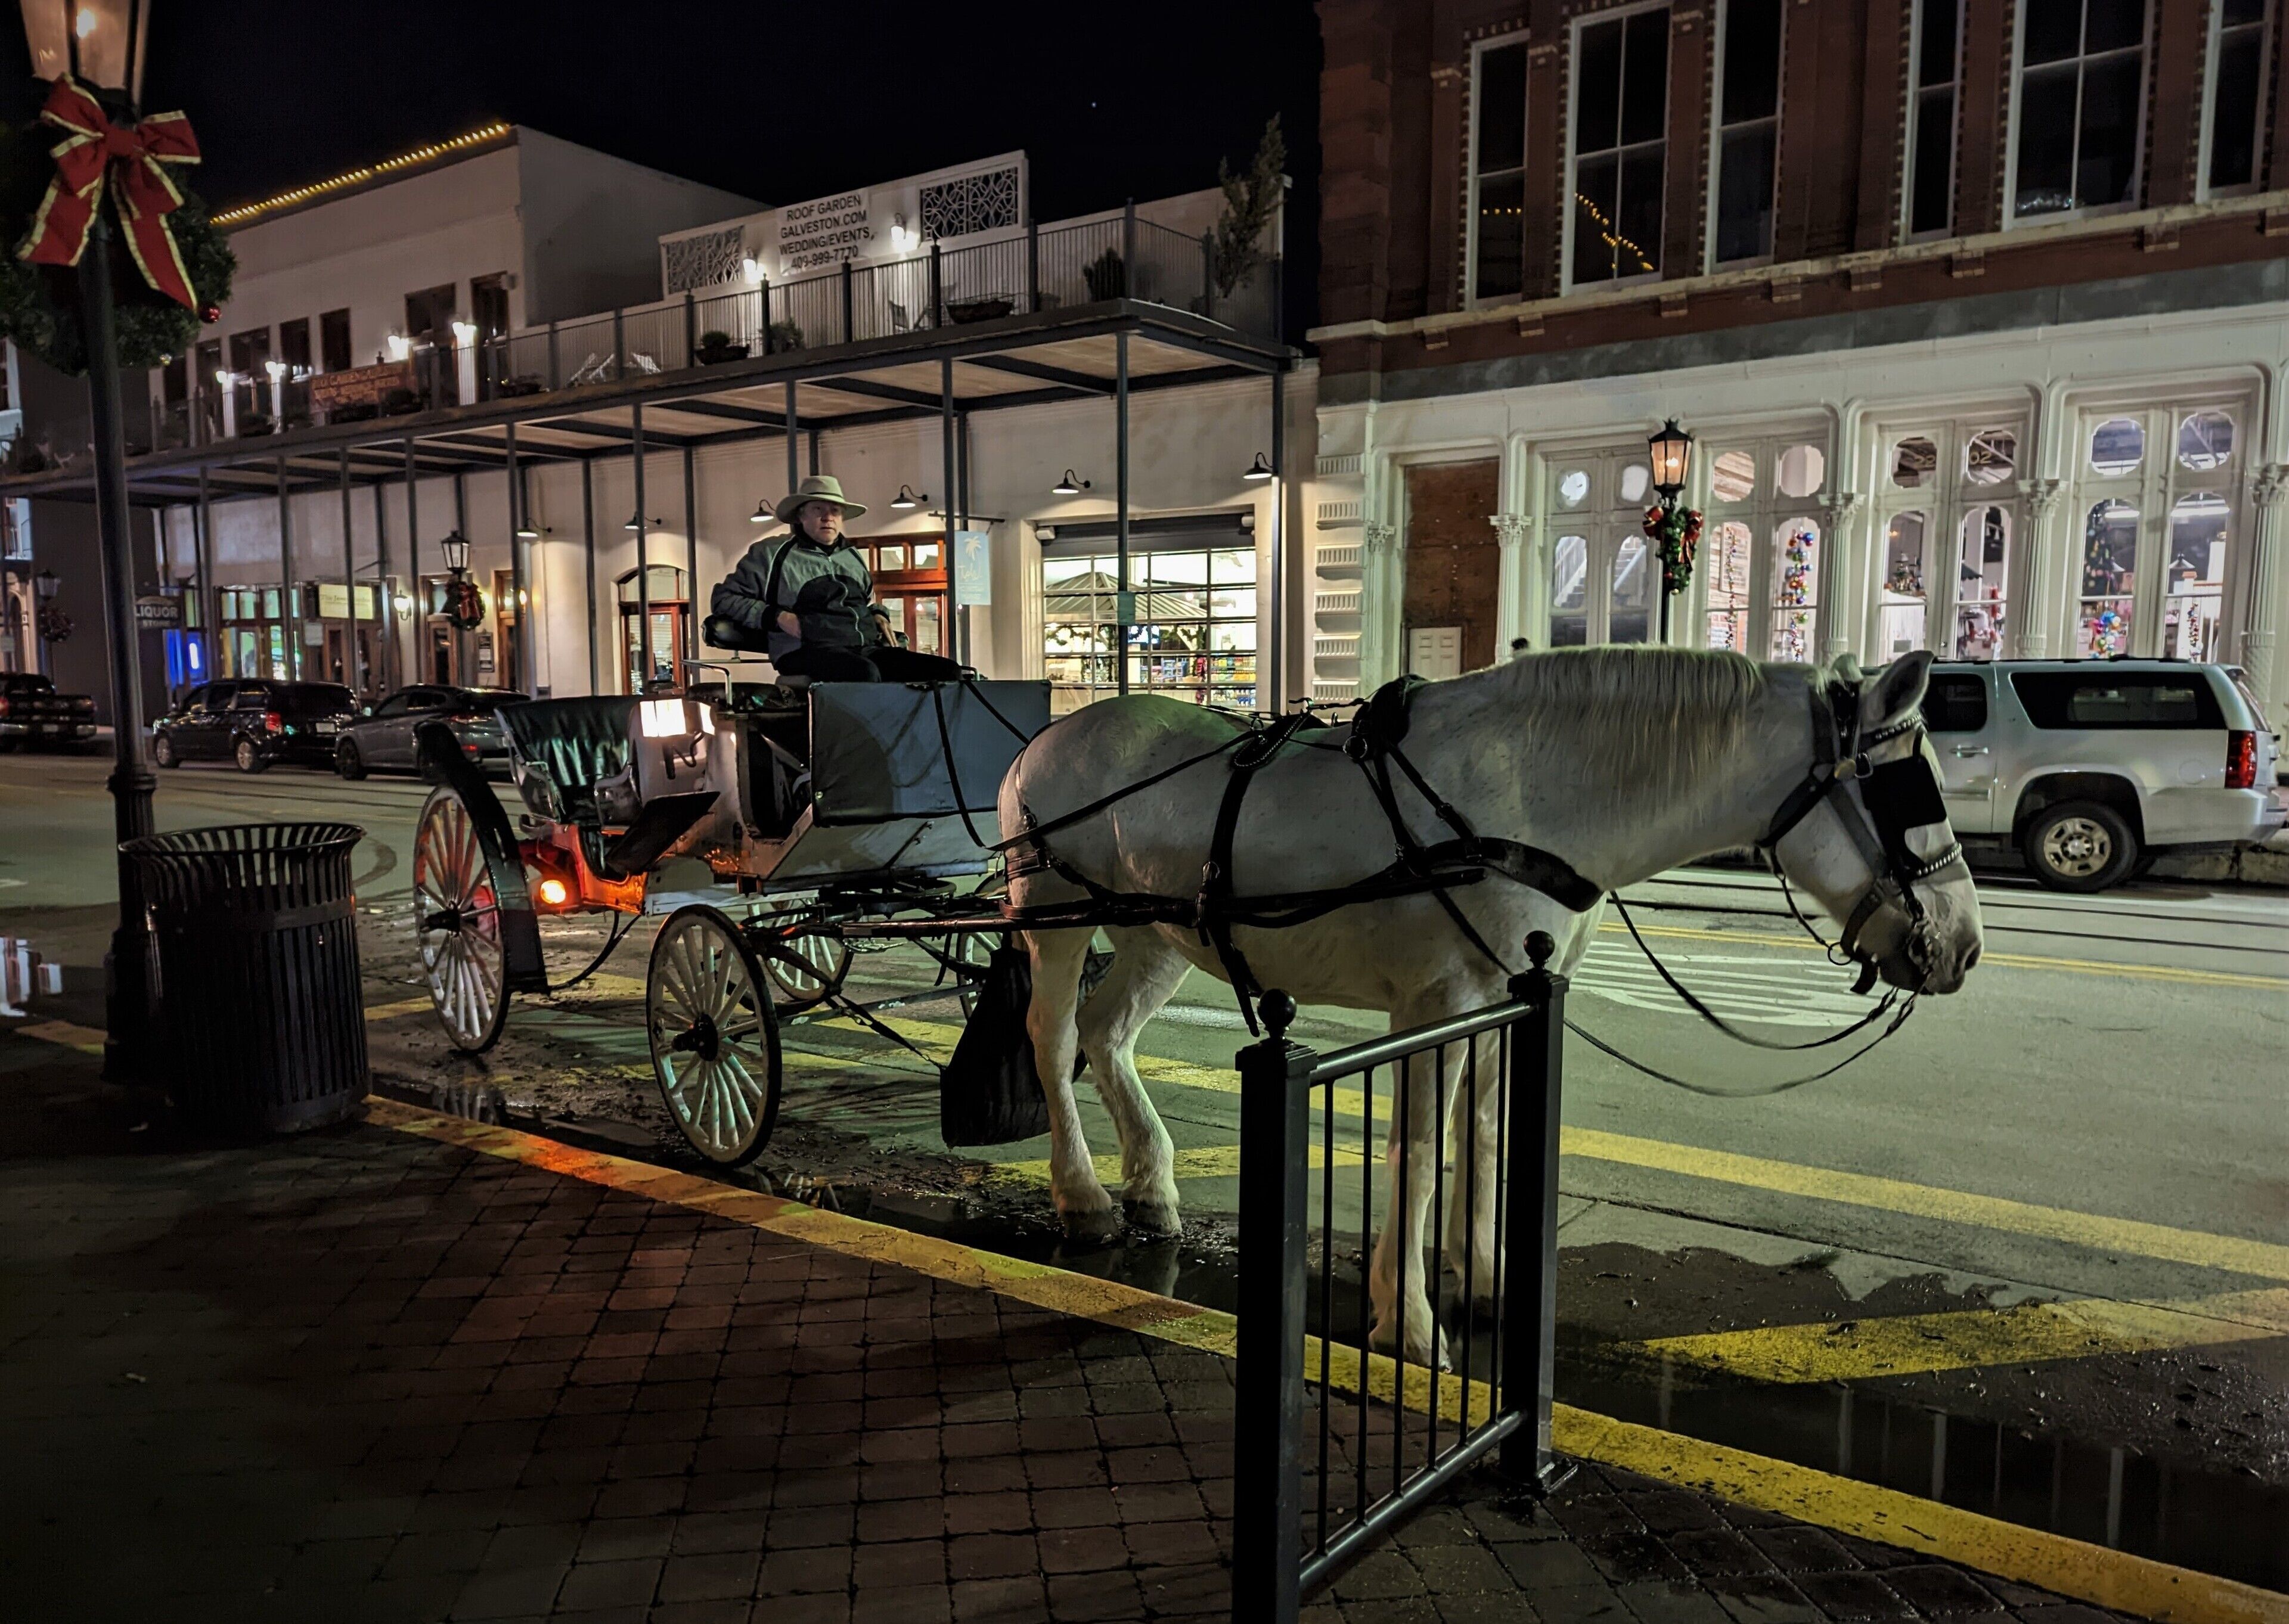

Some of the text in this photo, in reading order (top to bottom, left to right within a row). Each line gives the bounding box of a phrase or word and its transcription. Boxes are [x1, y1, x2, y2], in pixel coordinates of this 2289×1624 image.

[786, 194, 861, 221] ROOF GARDEN
[781, 210, 867, 238] GALVESTON.COM
[791, 245, 859, 268] 409-999-7770
[1969, 451, 1992, 465] 02
[134, 605, 178, 618] LIQUOR
